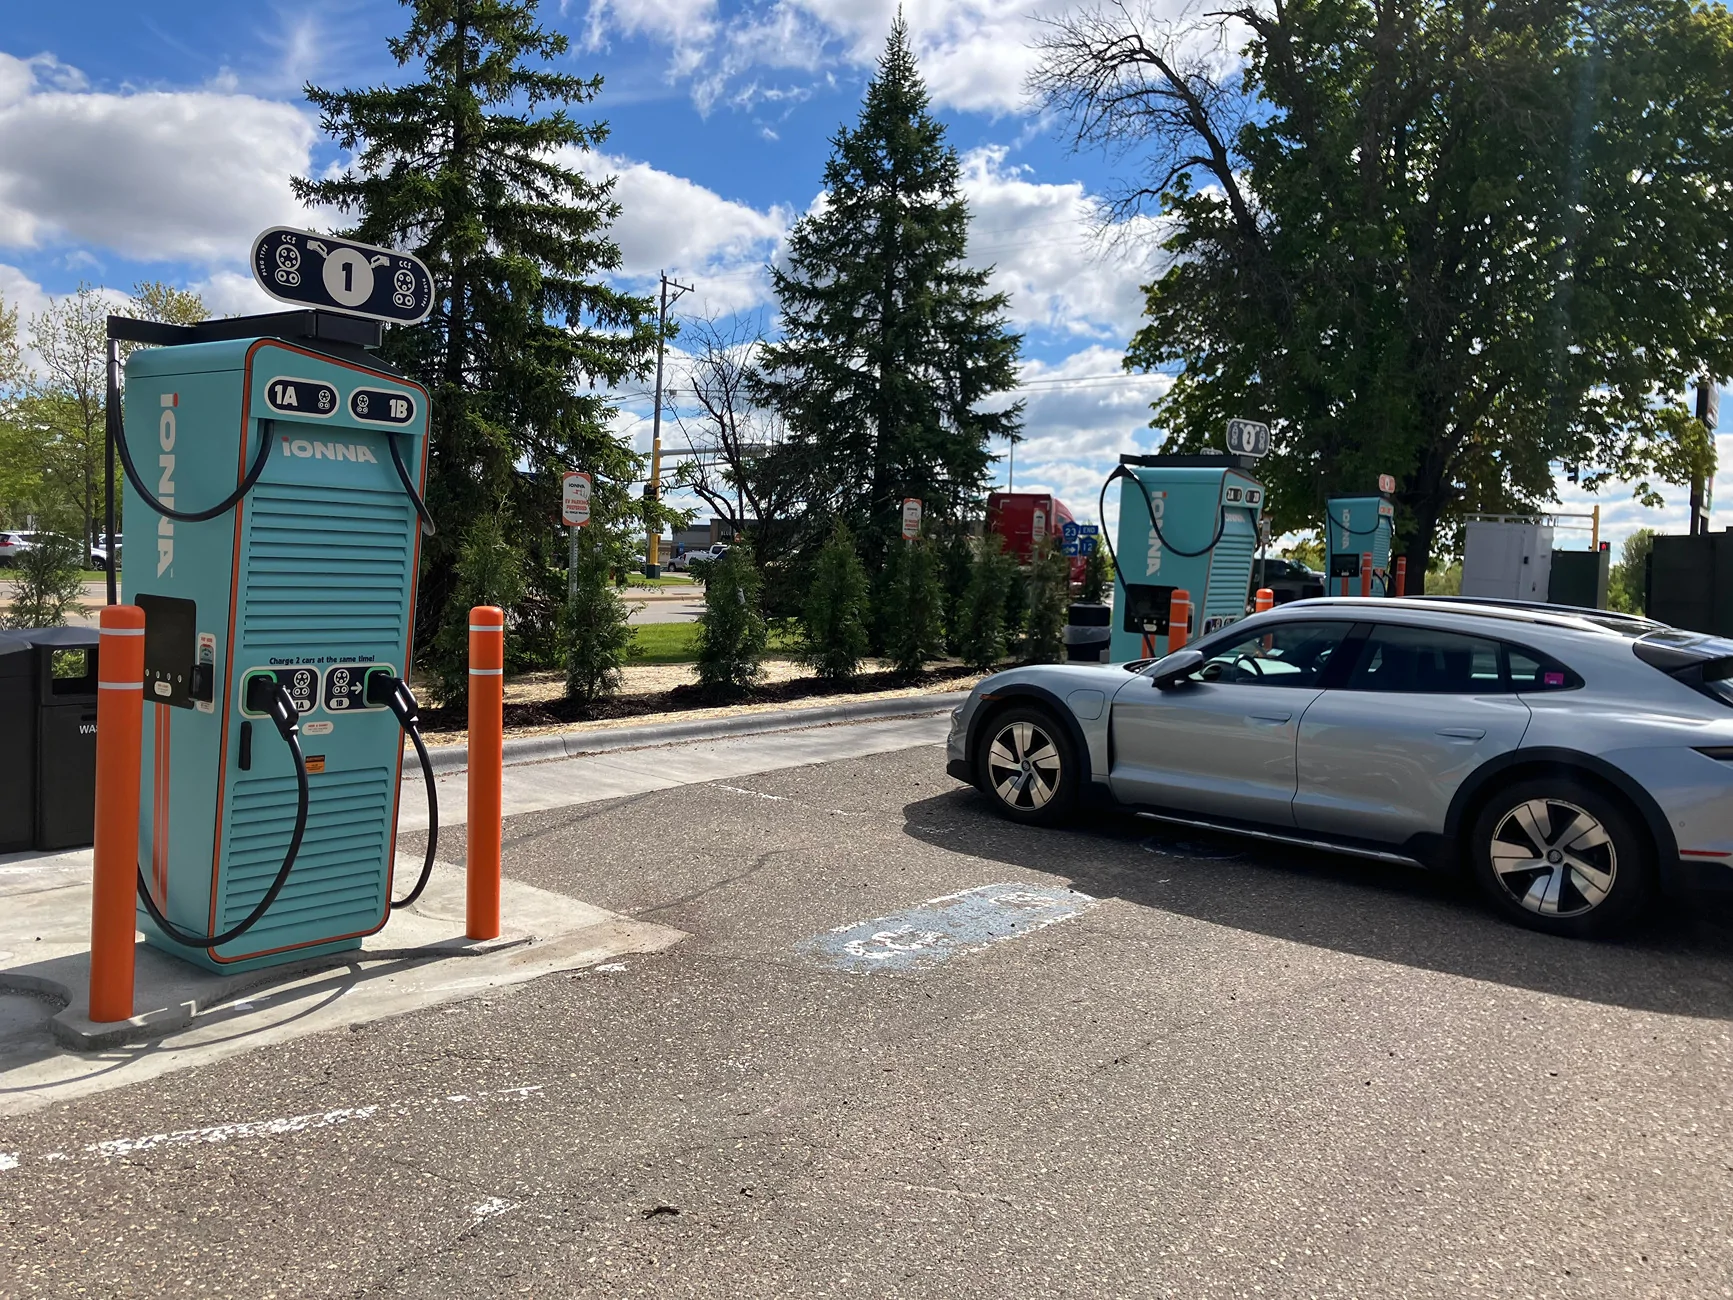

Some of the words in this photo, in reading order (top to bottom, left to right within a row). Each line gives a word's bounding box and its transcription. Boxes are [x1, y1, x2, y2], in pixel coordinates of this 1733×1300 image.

[281, 234, 297, 244] CCS
[259, 244, 269, 259] TYPE
[398, 260, 412, 270] CCS
[341, 262, 354, 292] 1
[274, 384, 298, 407] 1A
[389, 399, 408, 419] 1B
[1065, 527, 1077, 537] 23
[1083, 526, 1096, 534] END
[1083, 543, 1093, 552] 12
[269, 657, 294, 665] Charge
[301, 656, 316, 664] cars
[317, 656, 325, 664] at
[295, 701, 305, 709] 1A
[79, 724, 97, 734] WA
